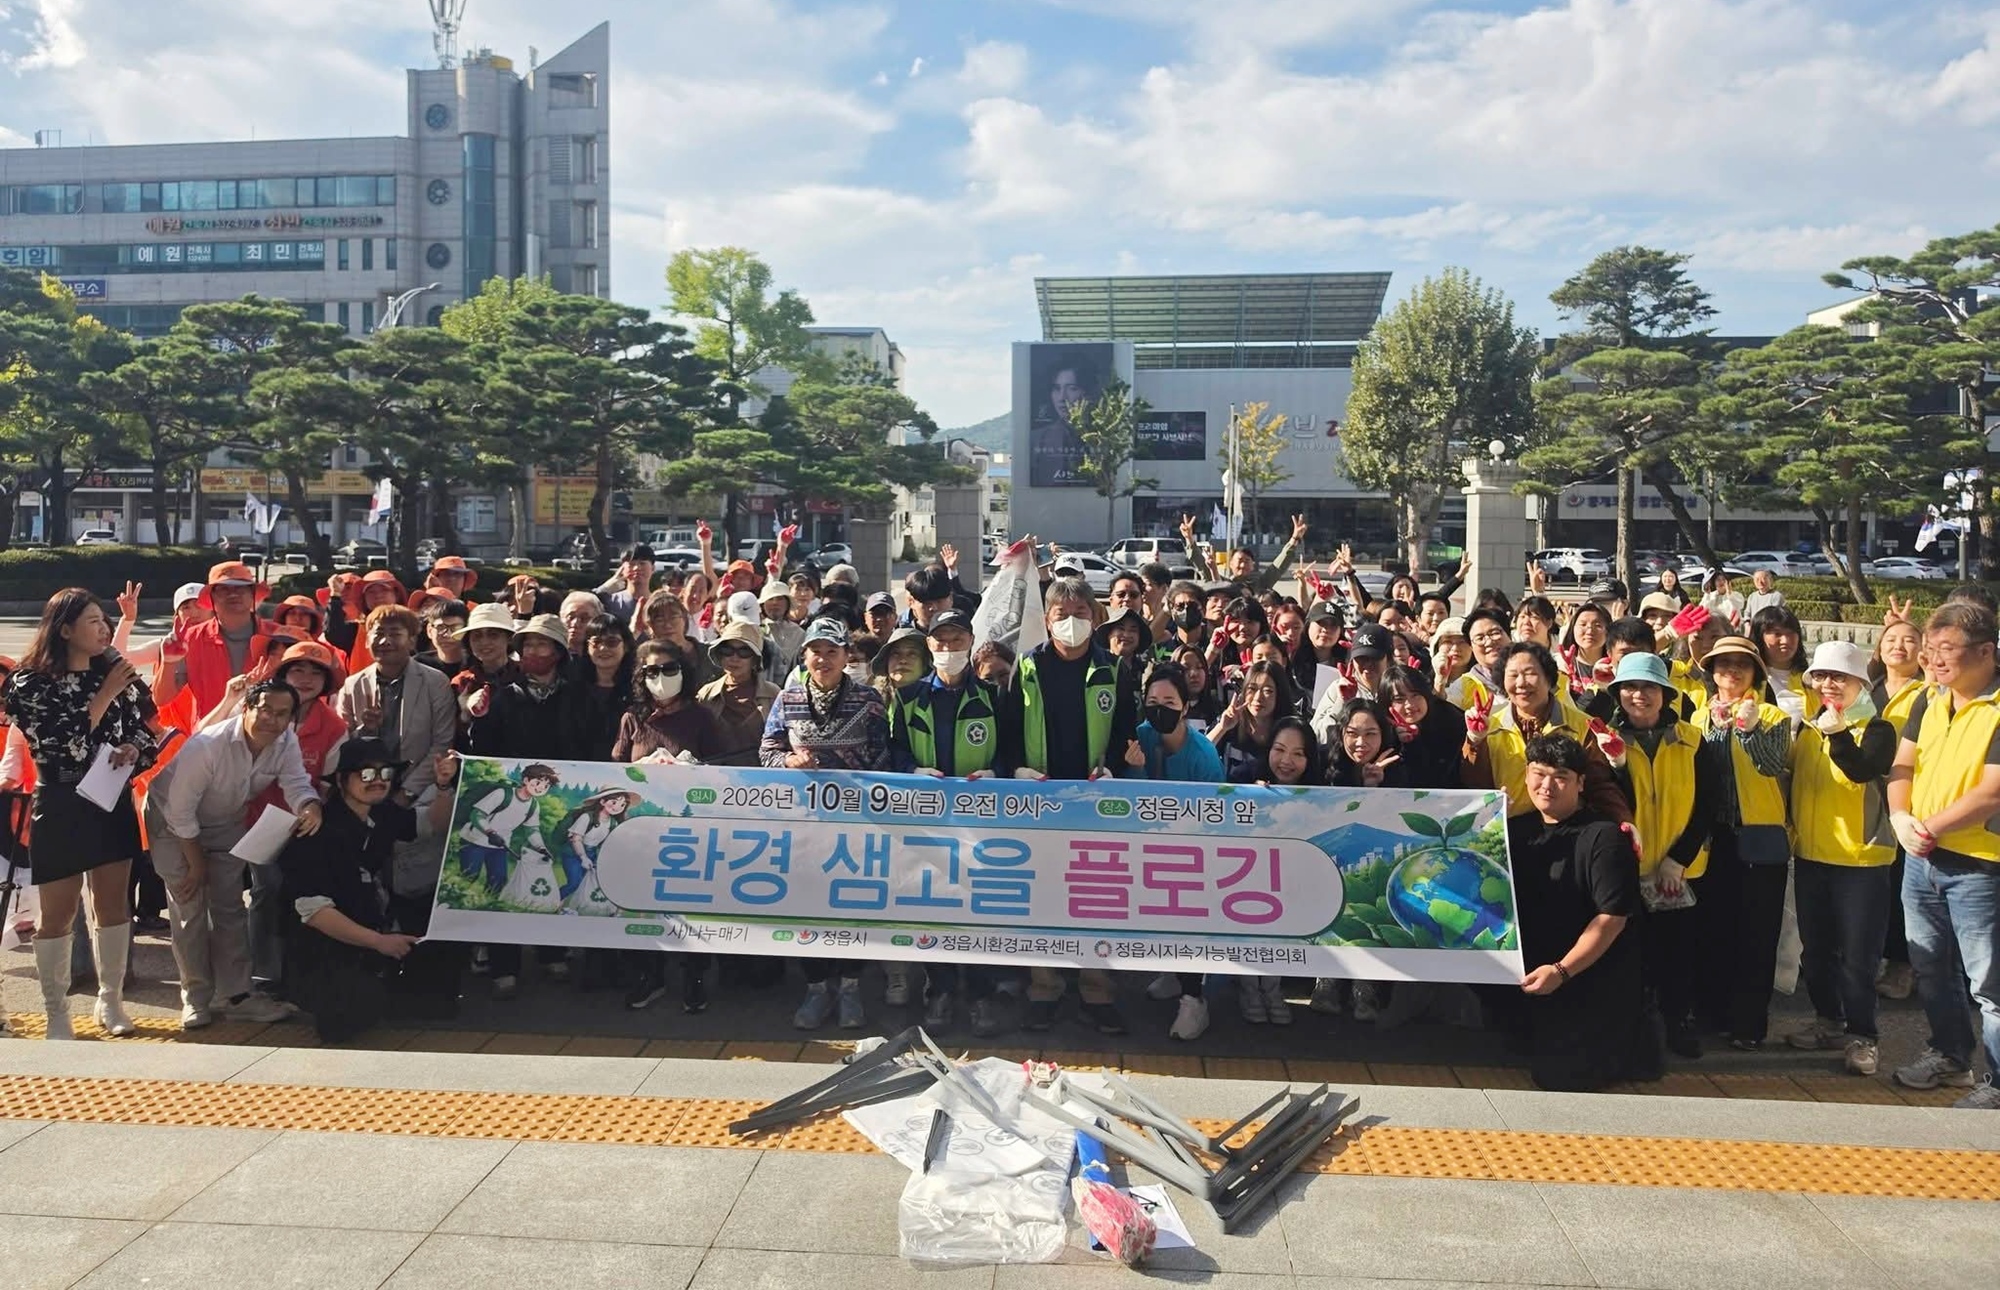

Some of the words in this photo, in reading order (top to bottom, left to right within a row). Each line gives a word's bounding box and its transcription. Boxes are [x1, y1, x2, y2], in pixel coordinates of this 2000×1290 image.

[691, 789, 713, 801] 일시
[722, 787, 794, 810] 2026년
[806, 782, 862, 813] 10월
[870, 784, 945, 816] 9일(금)
[953, 794, 997, 817] 오전
[1005, 795, 1062, 819] 9시~
[1102, 801, 1126, 814] 장소
[1136, 797, 1224, 824] 정읍시청
[1234, 800, 1256, 825] 앞
[651, 827, 792, 906] 환경
[821, 832, 1036, 917] 샘고을
[1064, 839, 1284, 925] 플로깅
[821, 929, 868, 947] 정읍시
[941, 934, 1084, 956] 정읍시환경교육센터,
[1115, 941, 1308, 965] 정읍시지속가능발전협의회
